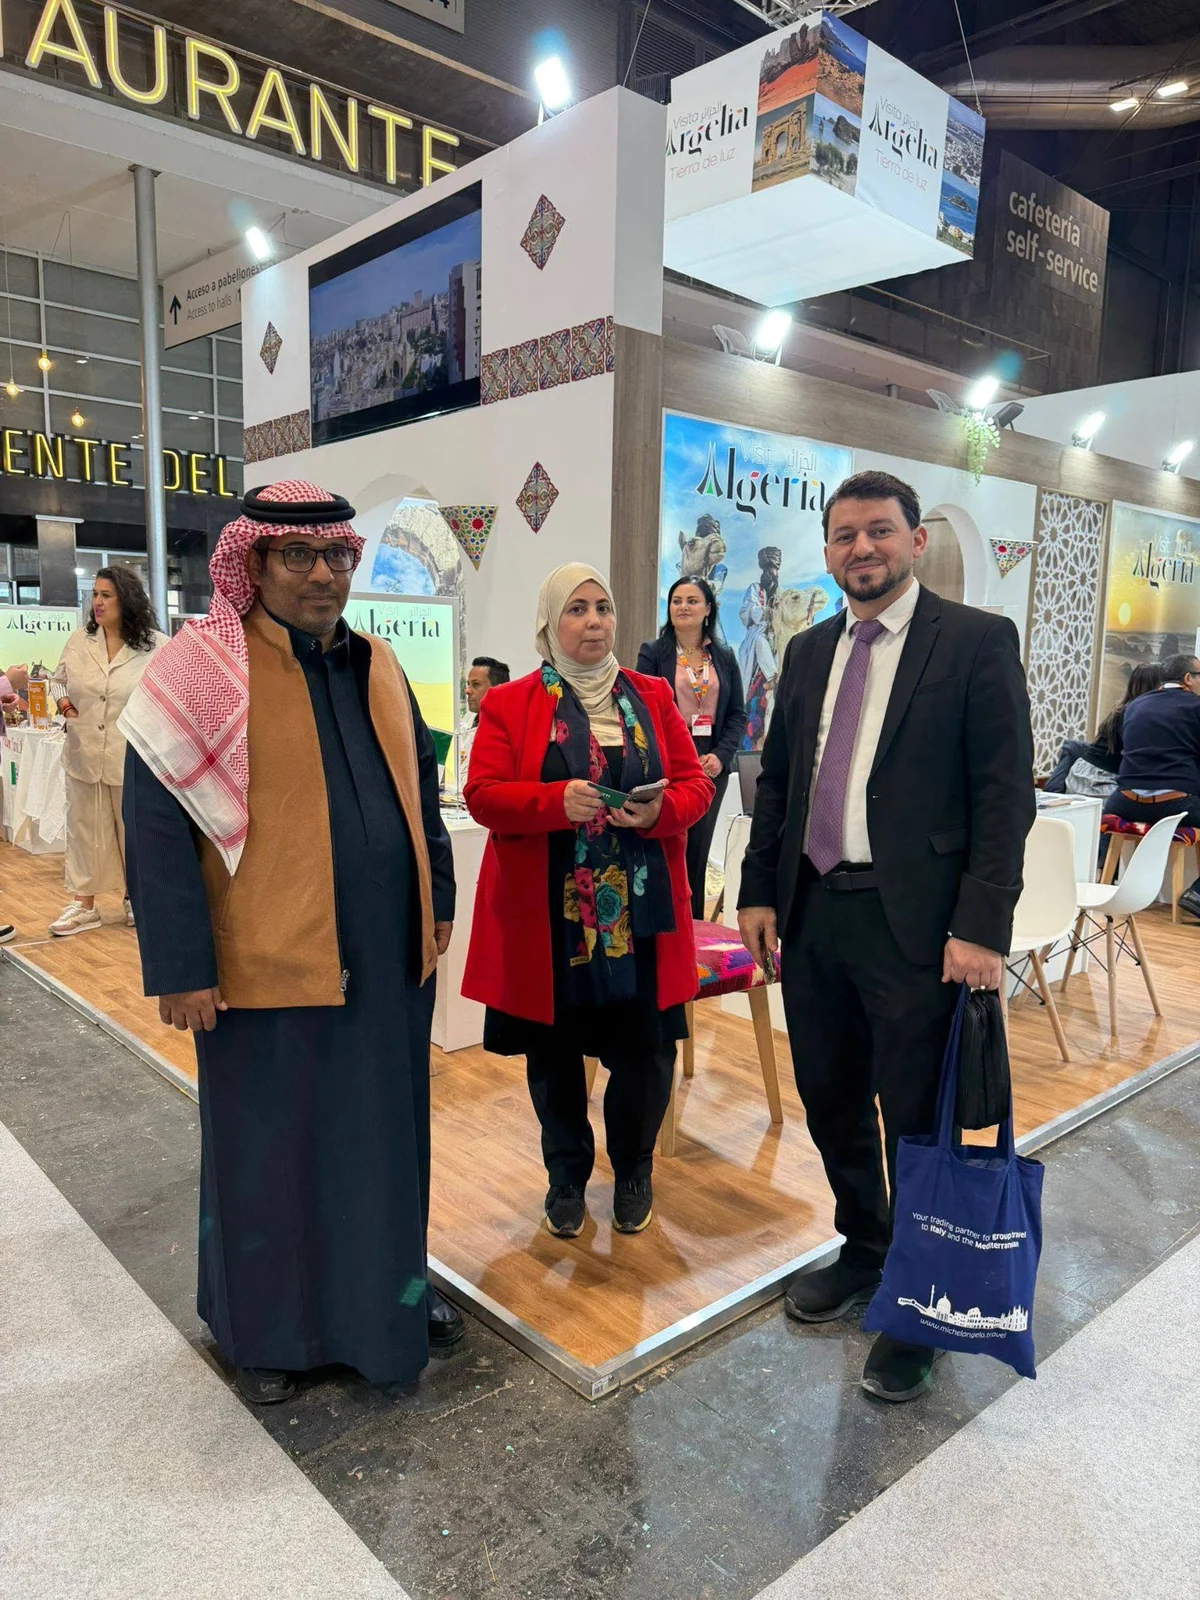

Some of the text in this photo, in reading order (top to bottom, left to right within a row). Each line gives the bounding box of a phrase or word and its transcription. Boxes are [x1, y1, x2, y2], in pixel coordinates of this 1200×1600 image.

[0, 0, 460, 187] AURANTE
[665, 104, 748, 157] Argelia
[868, 99, 938, 170] Argelia
[1009, 191, 1081, 248] cafetería
[186, 263, 261, 301] Acceso a pabellones
[1006, 229, 1099, 293] self-service
[187, 304, 208, 320] Access
[208, 301, 215, 314] to
[216, 293, 232, 310] halls
[2, 428, 132, 487] ENTE
[162, 449, 236, 497] DEL
[740, 436, 772, 465] Visit
[696, 441, 826, 525] Algeria
[1132, 542, 1194, 590] Algeria
[6, 613, 71, 636] Algeria
[352, 608, 440, 646] Algeria
[912, 1212, 929, 1222] Your
[930, 1215, 954, 1231] trading
[954, 1226, 981, 1240] partner
[921, 1223, 929, 1231] to
[930, 1224, 947, 1237] Italy
[947, 1232, 960, 1242] and
[962, 1236, 974, 1246] the
